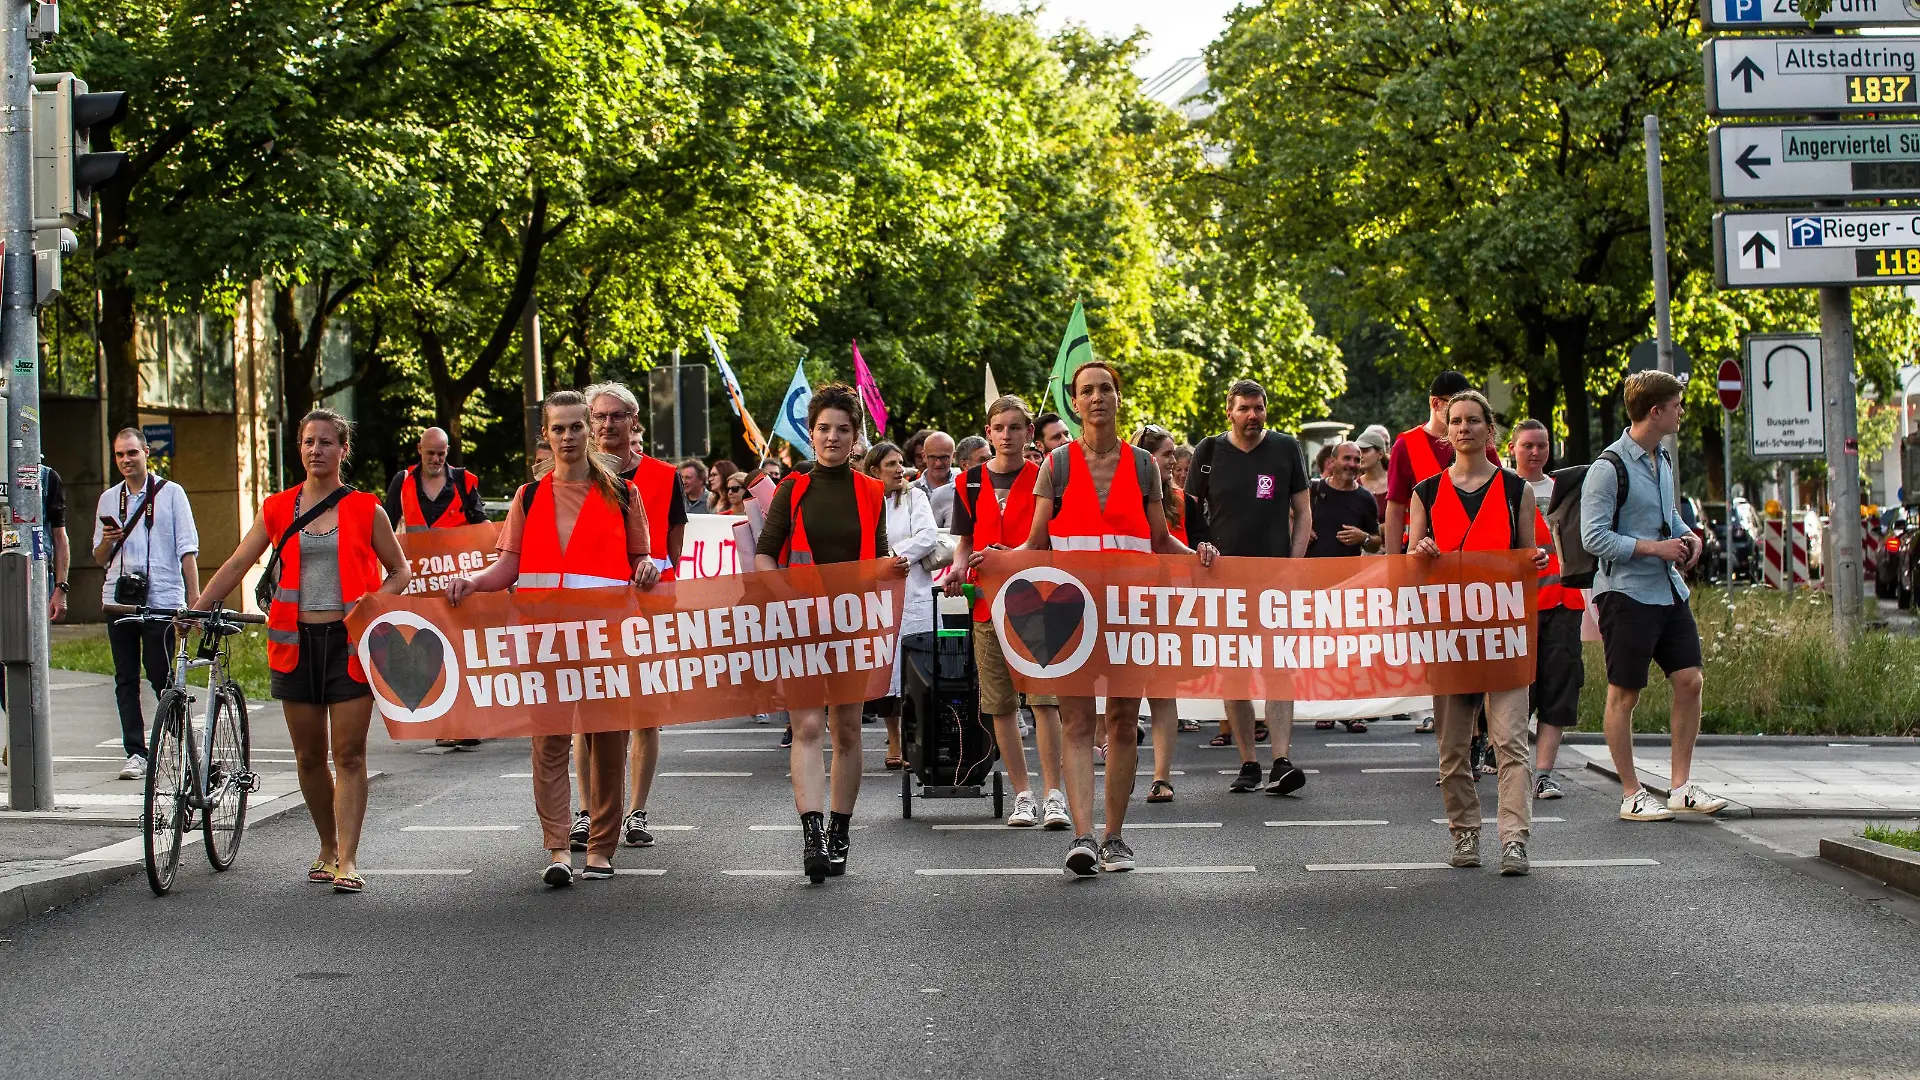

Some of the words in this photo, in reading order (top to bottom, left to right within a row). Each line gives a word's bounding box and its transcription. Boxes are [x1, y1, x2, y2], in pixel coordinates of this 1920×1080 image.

[1785, 47, 1915, 72] Altstadtring
[1850, 76, 1911, 103] 1837
[1788, 133, 1892, 160] Angerviertel
[1824, 217, 1891, 242] Rieger
[1875, 248, 1920, 276] 118
[15, 359, 34, 369] Jazz
[1766, 417, 1810, 427] Busparken
[418, 554, 456, 576] 20A
[458, 550, 484, 570] GG
[1106, 585, 1248, 628] LETZTE
[1259, 581, 1526, 630] GENERATION
[462, 619, 612, 669] LETZTE
[620, 589, 894, 657] GENERATION
[1104, 631, 1182, 666] VOR
[1192, 634, 1263, 668] DEN
[1273, 624, 1528, 669] KIPPPUNKTEN
[465, 671, 548, 708] VOR
[555, 664, 631, 703] DEN
[639, 633, 895, 696] KIPPPUNKTEN
